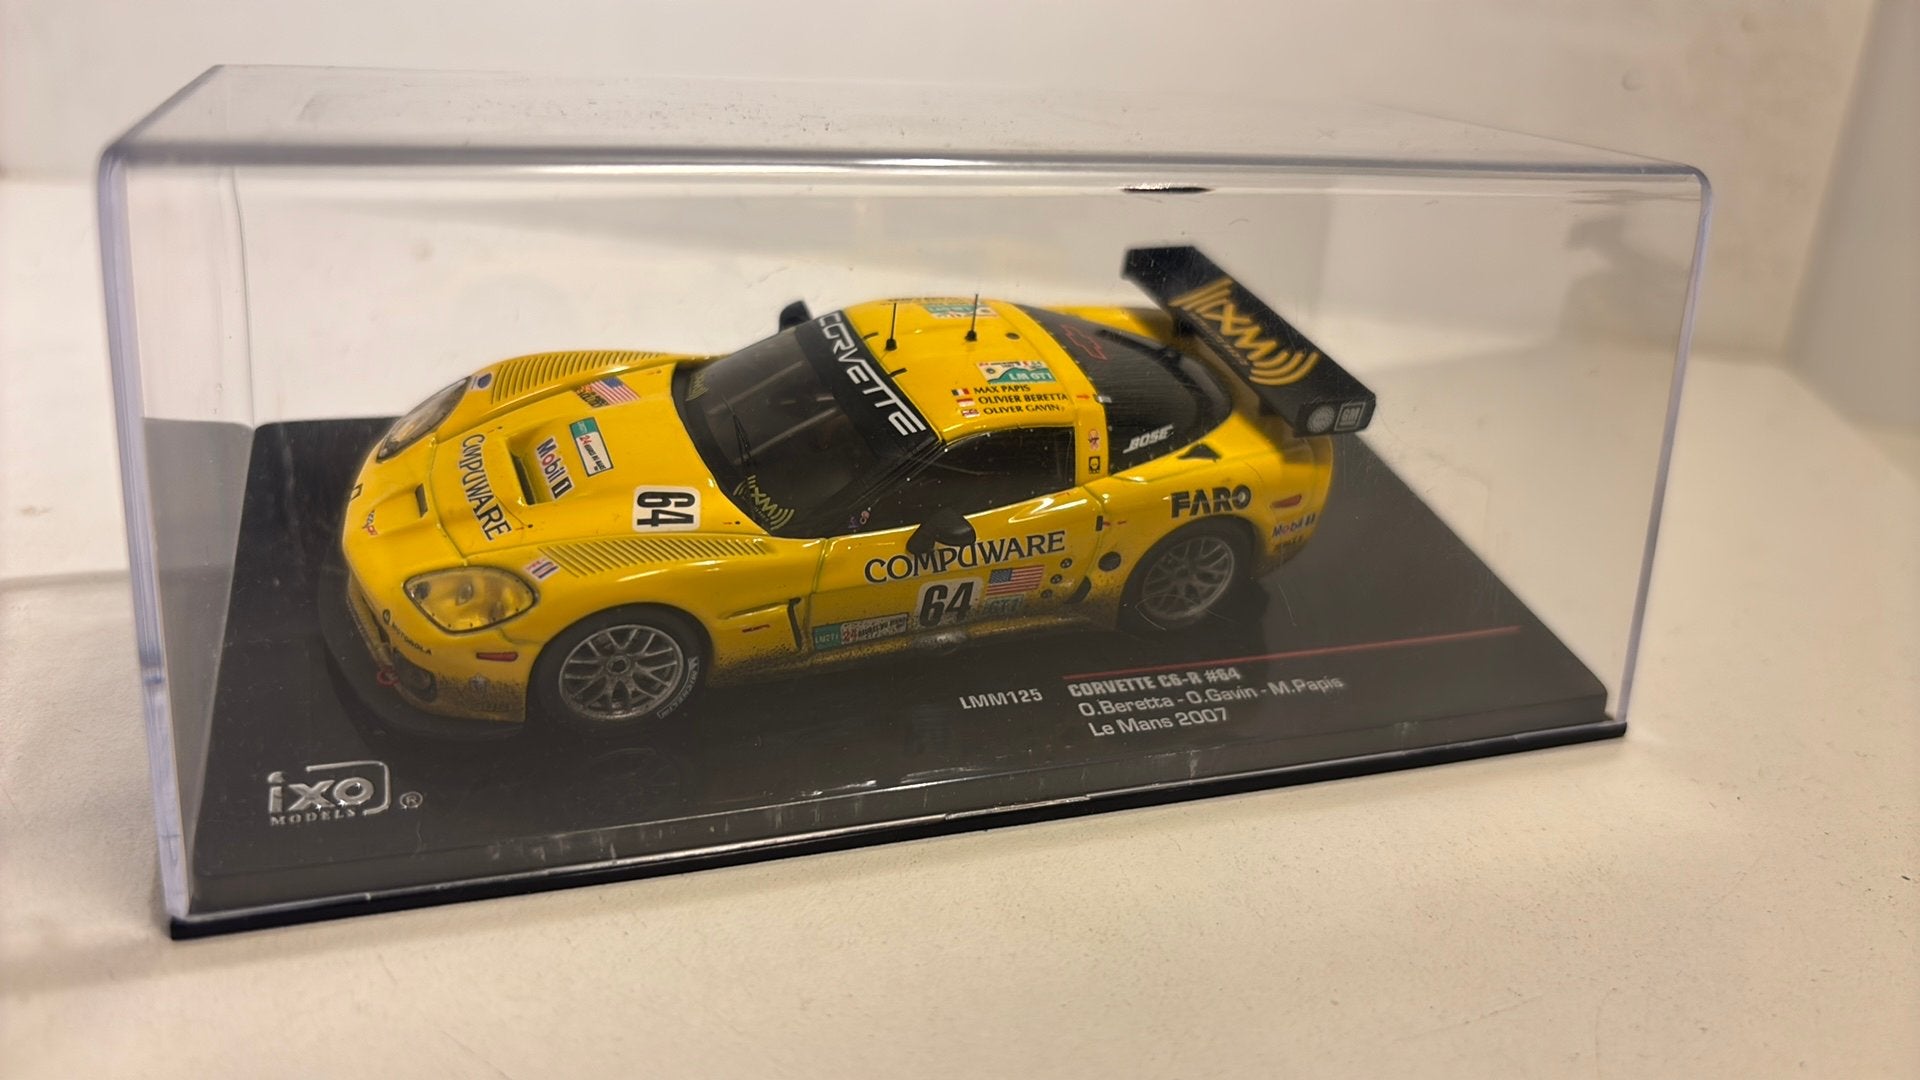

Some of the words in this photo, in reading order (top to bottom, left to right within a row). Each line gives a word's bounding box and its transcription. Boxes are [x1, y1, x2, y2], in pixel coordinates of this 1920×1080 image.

[818, 313, 928, 436] CORVETTE
[974, 385, 998, 395] MAX
[1001, 384, 1031, 394] PAPIS
[978, 395, 1021, 405] OLIVIER
[1023, 393, 1068, 403] BERETTA
[983, 405, 1023, 415] OLIVER
[1026, 404, 1061, 413] GAVIN
[1123, 425, 1173, 453] BOSE
[537, 437, 563, 485] Mobil
[637, 491, 697, 527] 64
[1171, 485, 1251, 518] FARO
[865, 531, 1065, 583] COMPUWARE
[919, 582, 975, 627] 64
[1067, 676, 1156, 697] CORVETTE
[1157, 671, 1203, 688] C6-R
[1204, 667, 1241, 683] #64
[1078, 696, 1174, 716] O.Beretta
[1185, 686, 1258, 705] O.Gavin
[1267, 676, 1346, 696] M.Papis
[959, 688, 1043, 709] LMM125
[1088, 722, 1115, 737] Le
[1116, 716, 1173, 732] Mans
[1175, 707, 1228, 726] 2007
[270, 809, 356, 826] MODELS
